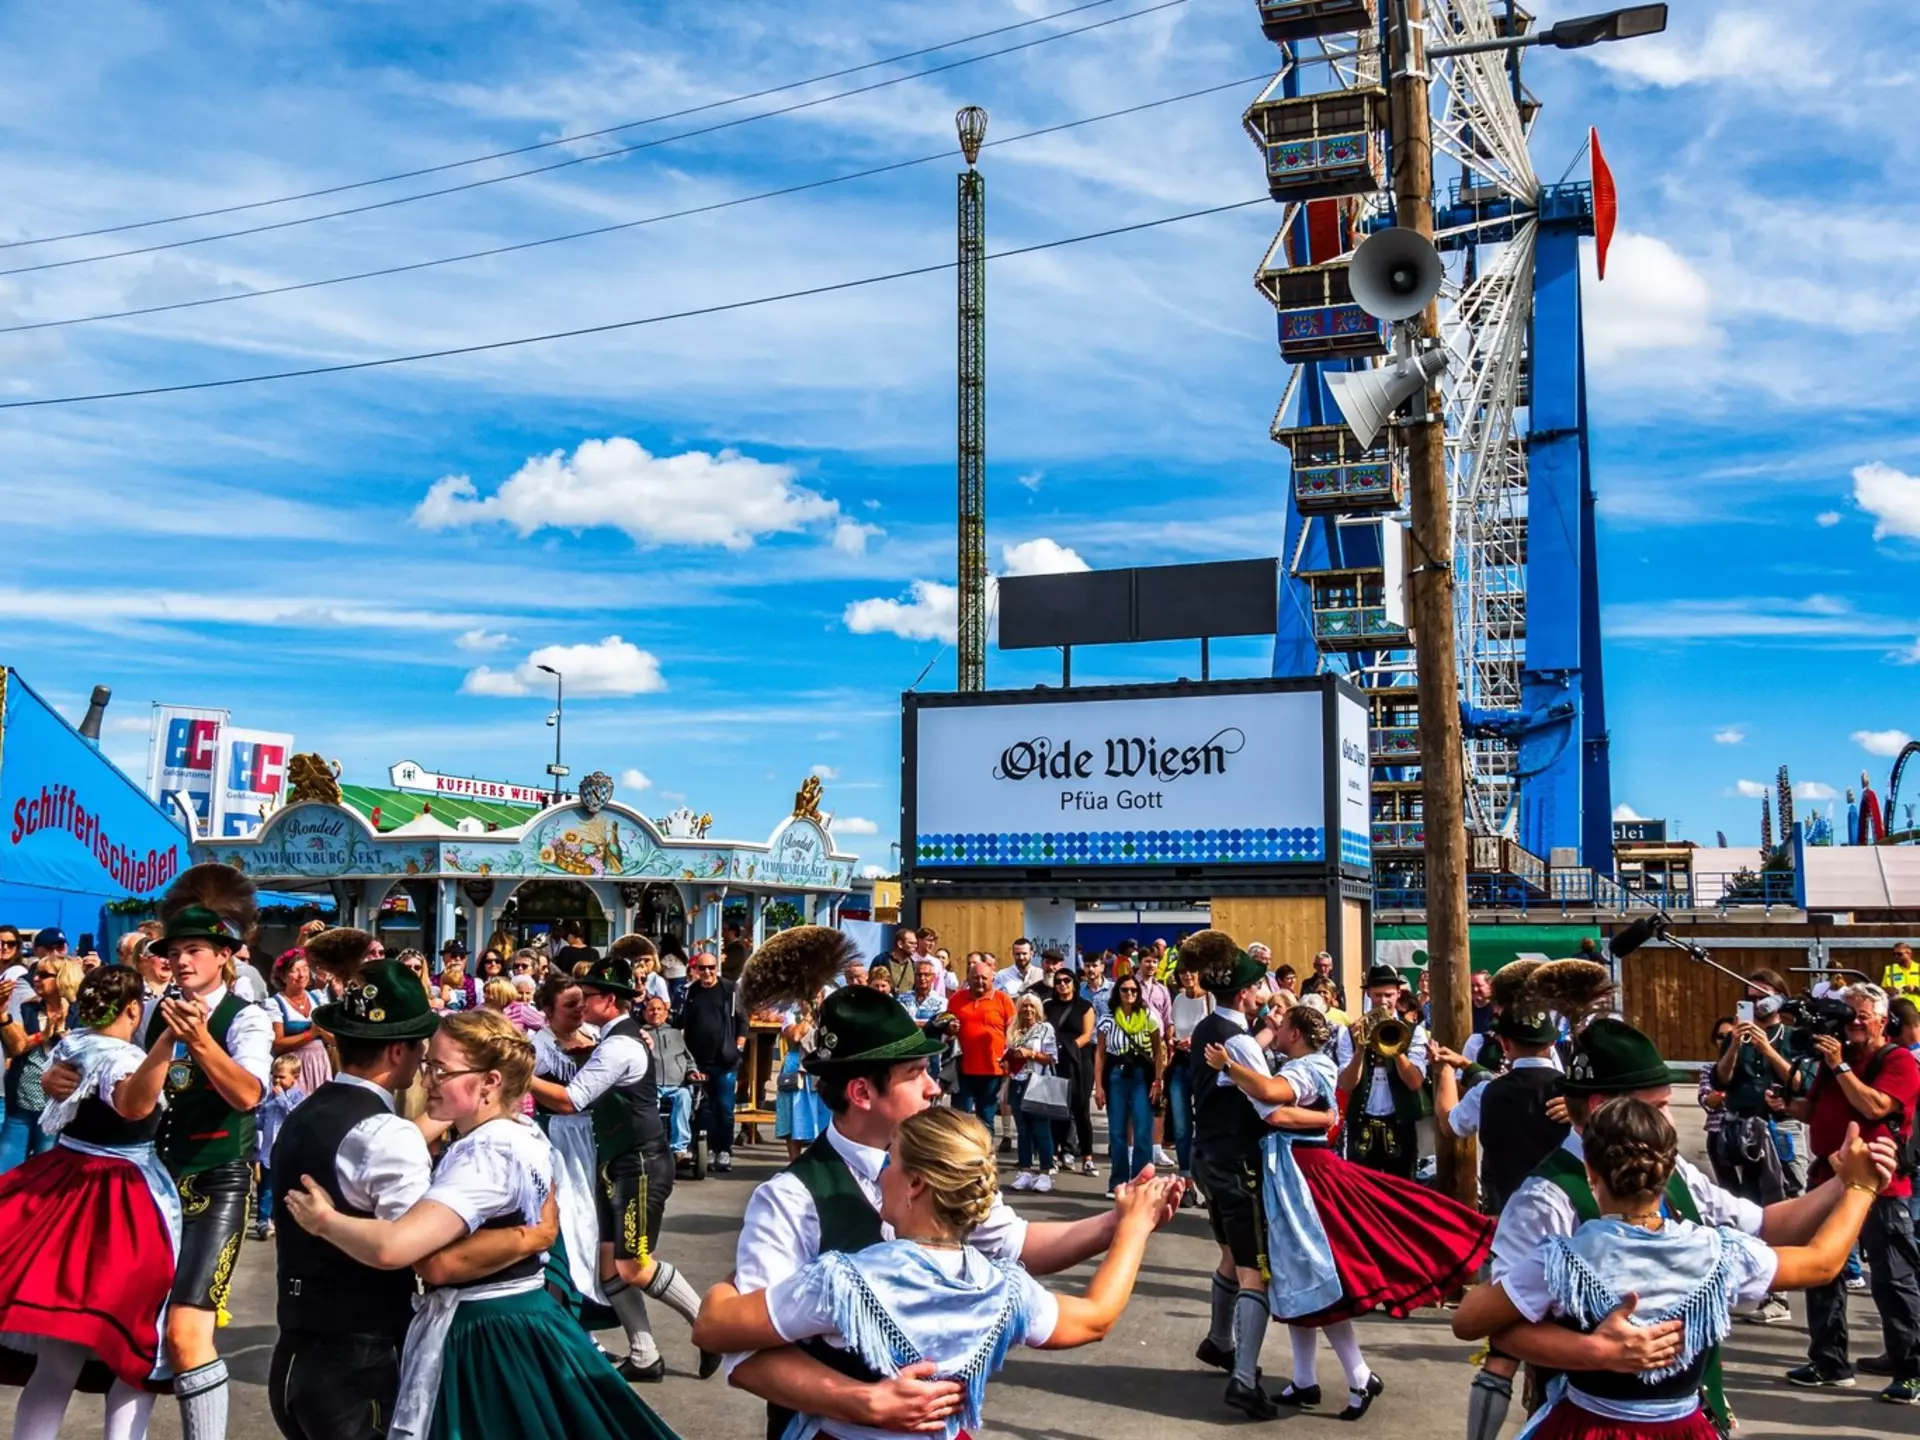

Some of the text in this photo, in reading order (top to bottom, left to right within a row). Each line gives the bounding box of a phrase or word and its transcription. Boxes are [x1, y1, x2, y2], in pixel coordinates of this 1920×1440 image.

[993, 727, 1246, 783] Oide Wiesn
[436, 776, 505, 798] KUFFLERS
[1061, 790, 1163, 810] Pfüa Gott
[11, 783, 178, 894] Schifferlschießen
[287, 818, 345, 839] Rondell
